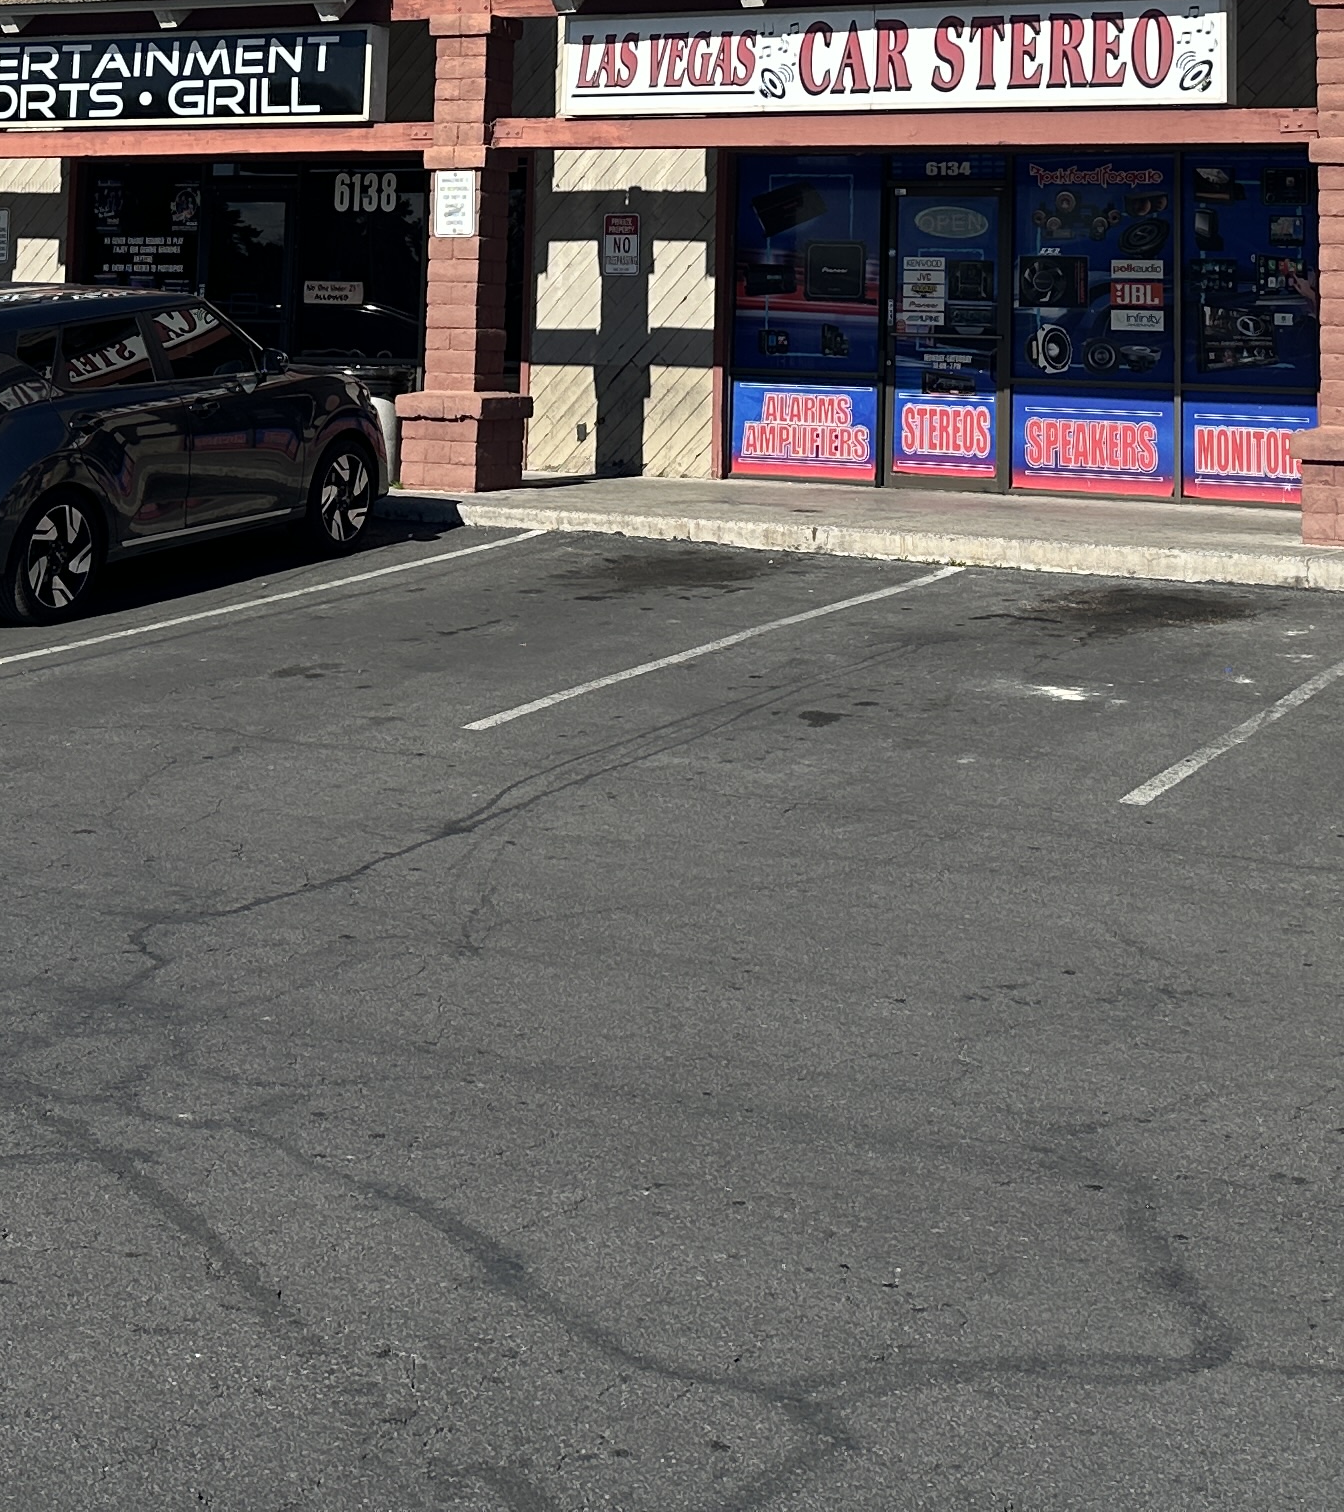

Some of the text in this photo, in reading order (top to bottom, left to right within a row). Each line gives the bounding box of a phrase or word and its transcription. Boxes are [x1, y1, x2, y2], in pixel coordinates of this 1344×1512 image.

[576, 8, 1175, 96] LAS VEGAS CAR STEREO
[168, 77, 320, 116] GRILL
[926, 162, 971, 175] 6134
[334, 173, 397, 212] 6138
[920, 214, 982, 233] OPEN
[613, 237, 631, 253] NO
[917, 273, 932, 281] JVC
[1116, 284, 1159, 305] JBL
[765, 392, 851, 426] ALARMS
[744, 422, 869, 461] AMPLIFIERS
[903, 405, 990, 458] STEREOS
[1026, 418, 1157, 473] SPEAKERS
[1195, 426, 1302, 478] MONITOR
